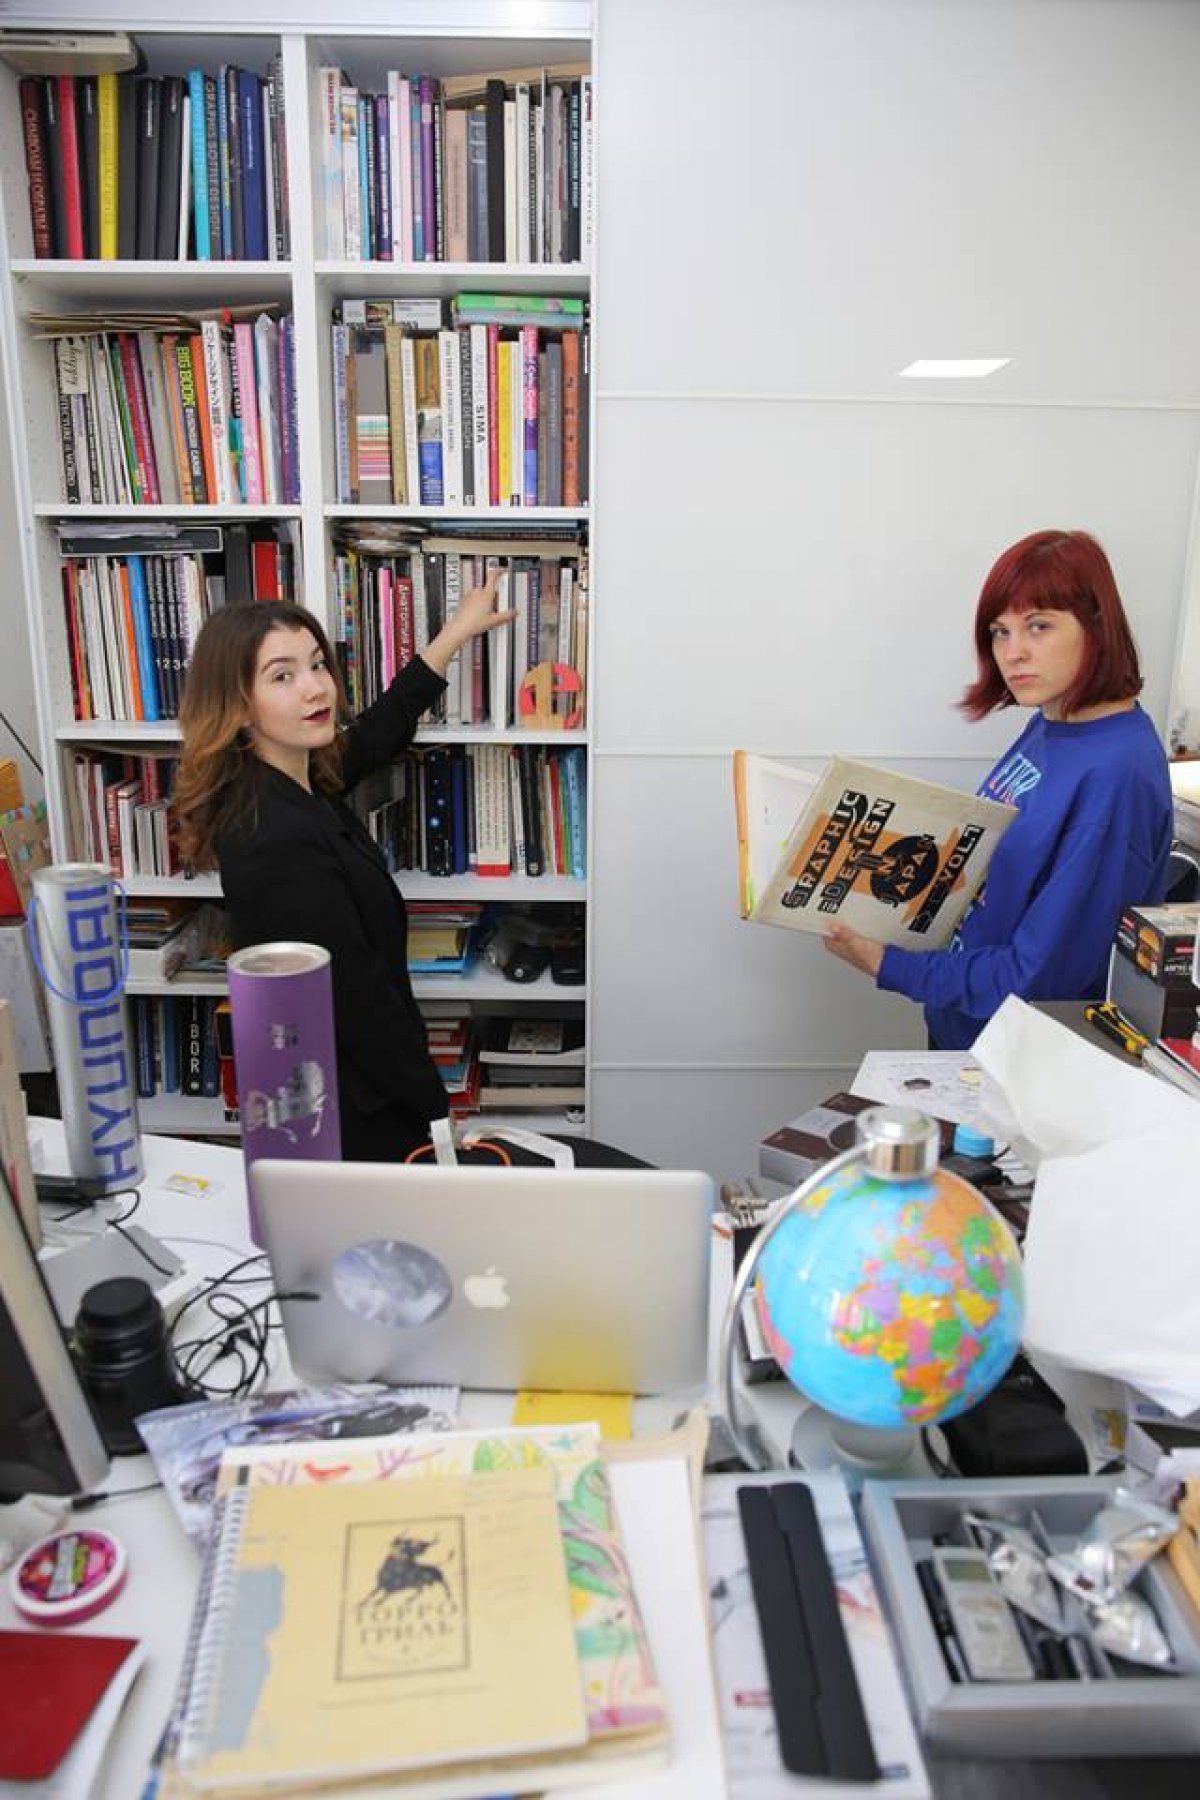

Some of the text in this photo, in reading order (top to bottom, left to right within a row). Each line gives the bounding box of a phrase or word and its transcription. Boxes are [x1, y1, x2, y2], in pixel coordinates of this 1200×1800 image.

[475, 404, 487, 444] SIMA
[781, 790, 862, 908] GRAPHIC
[65, 884, 137, 1186] HYUNDAI
